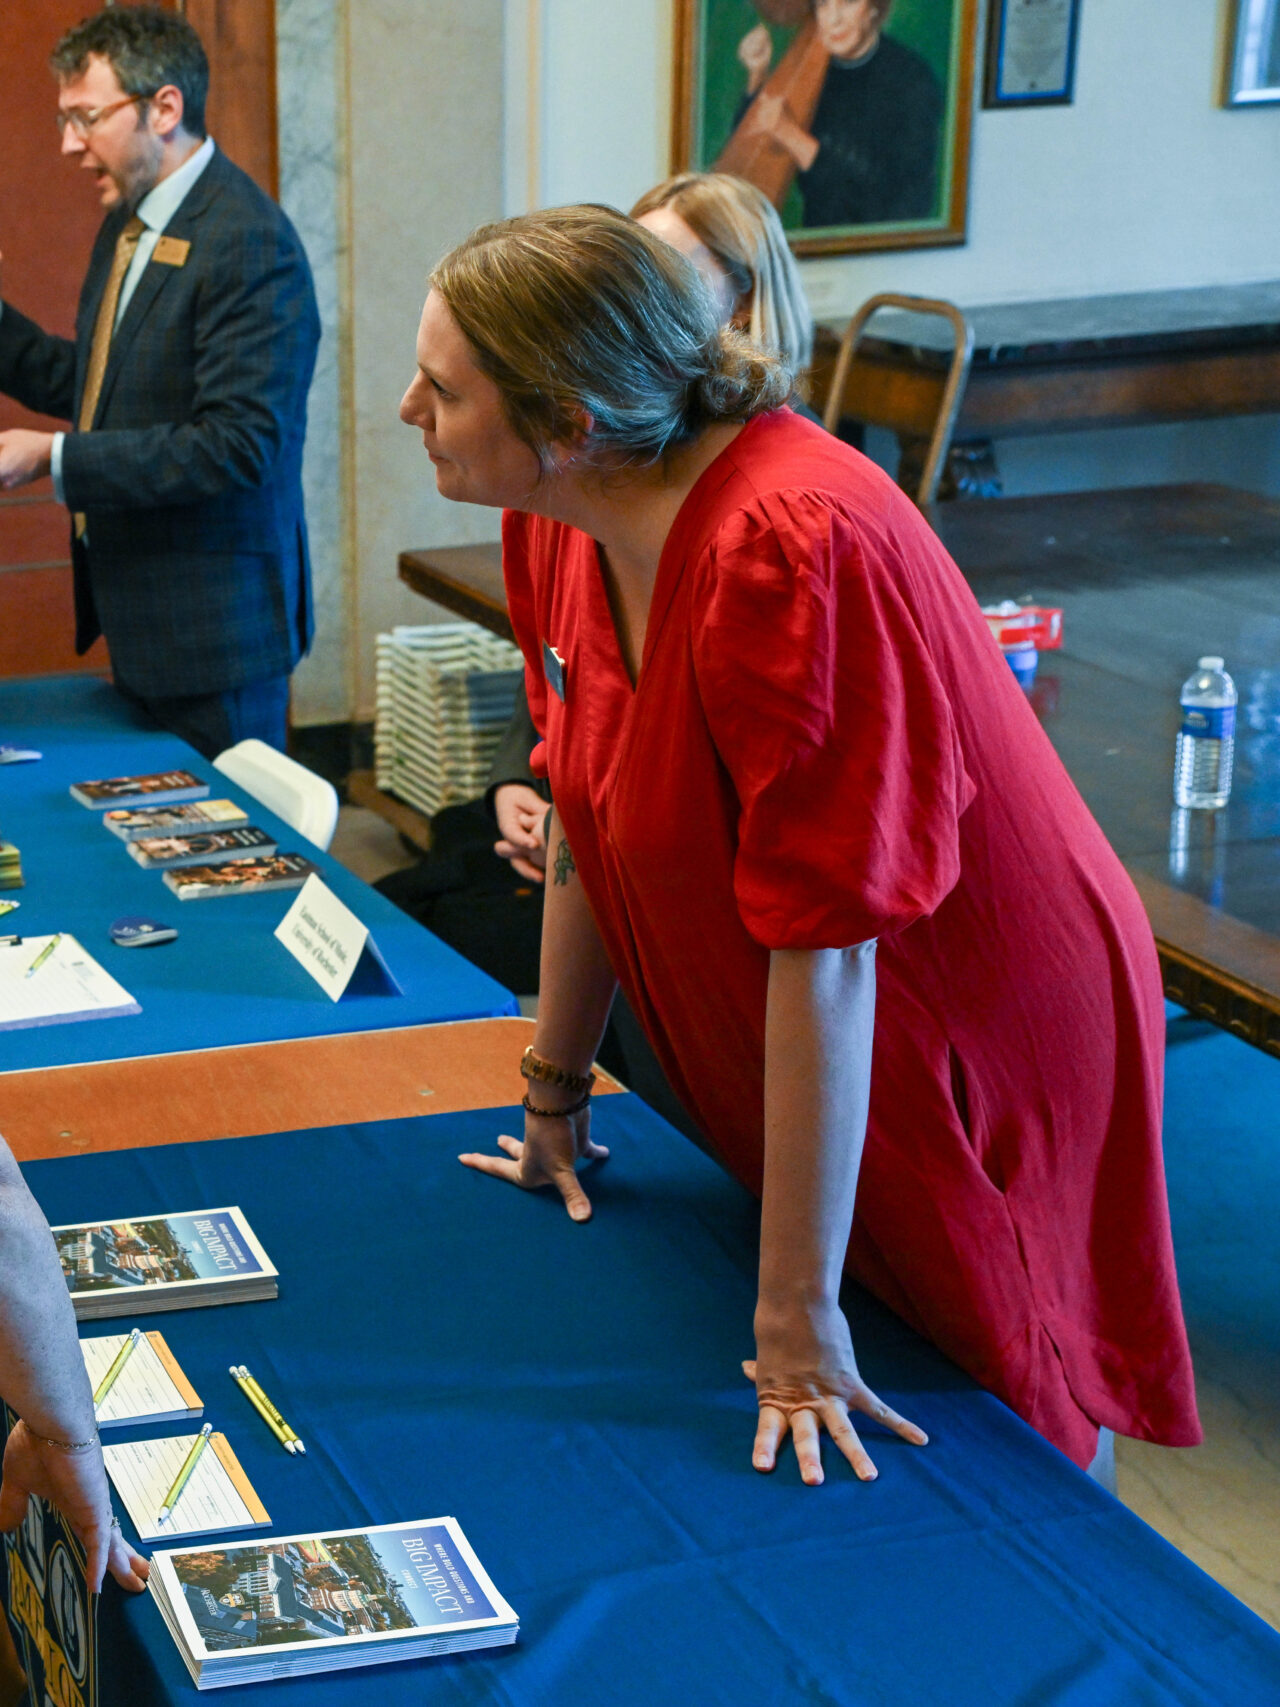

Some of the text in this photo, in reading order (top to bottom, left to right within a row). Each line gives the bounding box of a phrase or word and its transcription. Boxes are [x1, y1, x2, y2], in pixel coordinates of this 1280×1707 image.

[193, 1220, 217, 1236] BIG
[202, 1236, 237, 1270] IMPACT
[402, 1538, 464, 1614] BIG IMPACT
[434, 1543, 475, 1604] WHERE BOLD QUESTIONS AND
